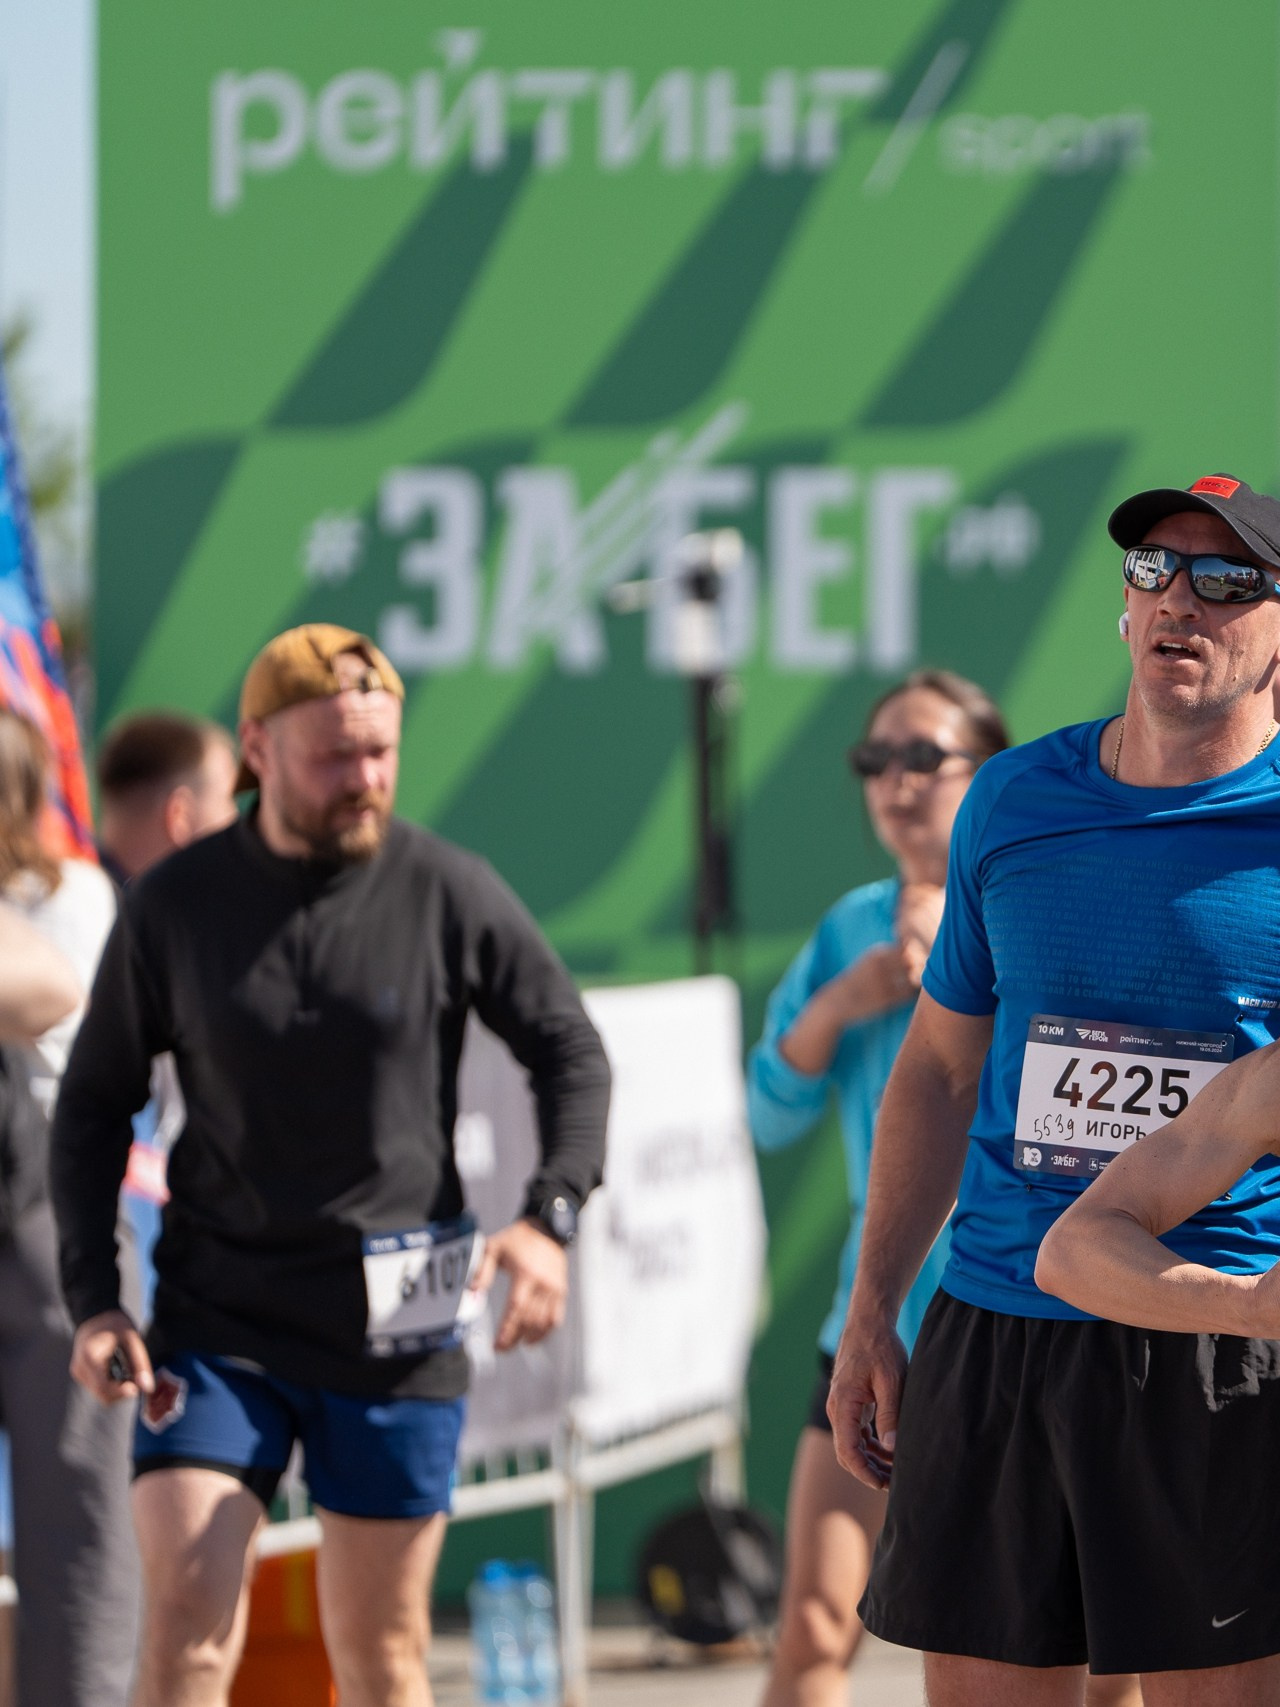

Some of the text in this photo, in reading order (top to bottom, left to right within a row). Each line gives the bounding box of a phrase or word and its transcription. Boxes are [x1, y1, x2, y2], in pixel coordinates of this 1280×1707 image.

[210, 25, 893, 213] рейтинг
[1237, 996, 1261, 1008] MACH
[1260, 999, 1278, 1009] DICH
[1038, 1024, 1048, 1034] 10
[1053, 1057, 1190, 1119] 4225
[1086, 1119, 1147, 1142] ИГОРЬ
